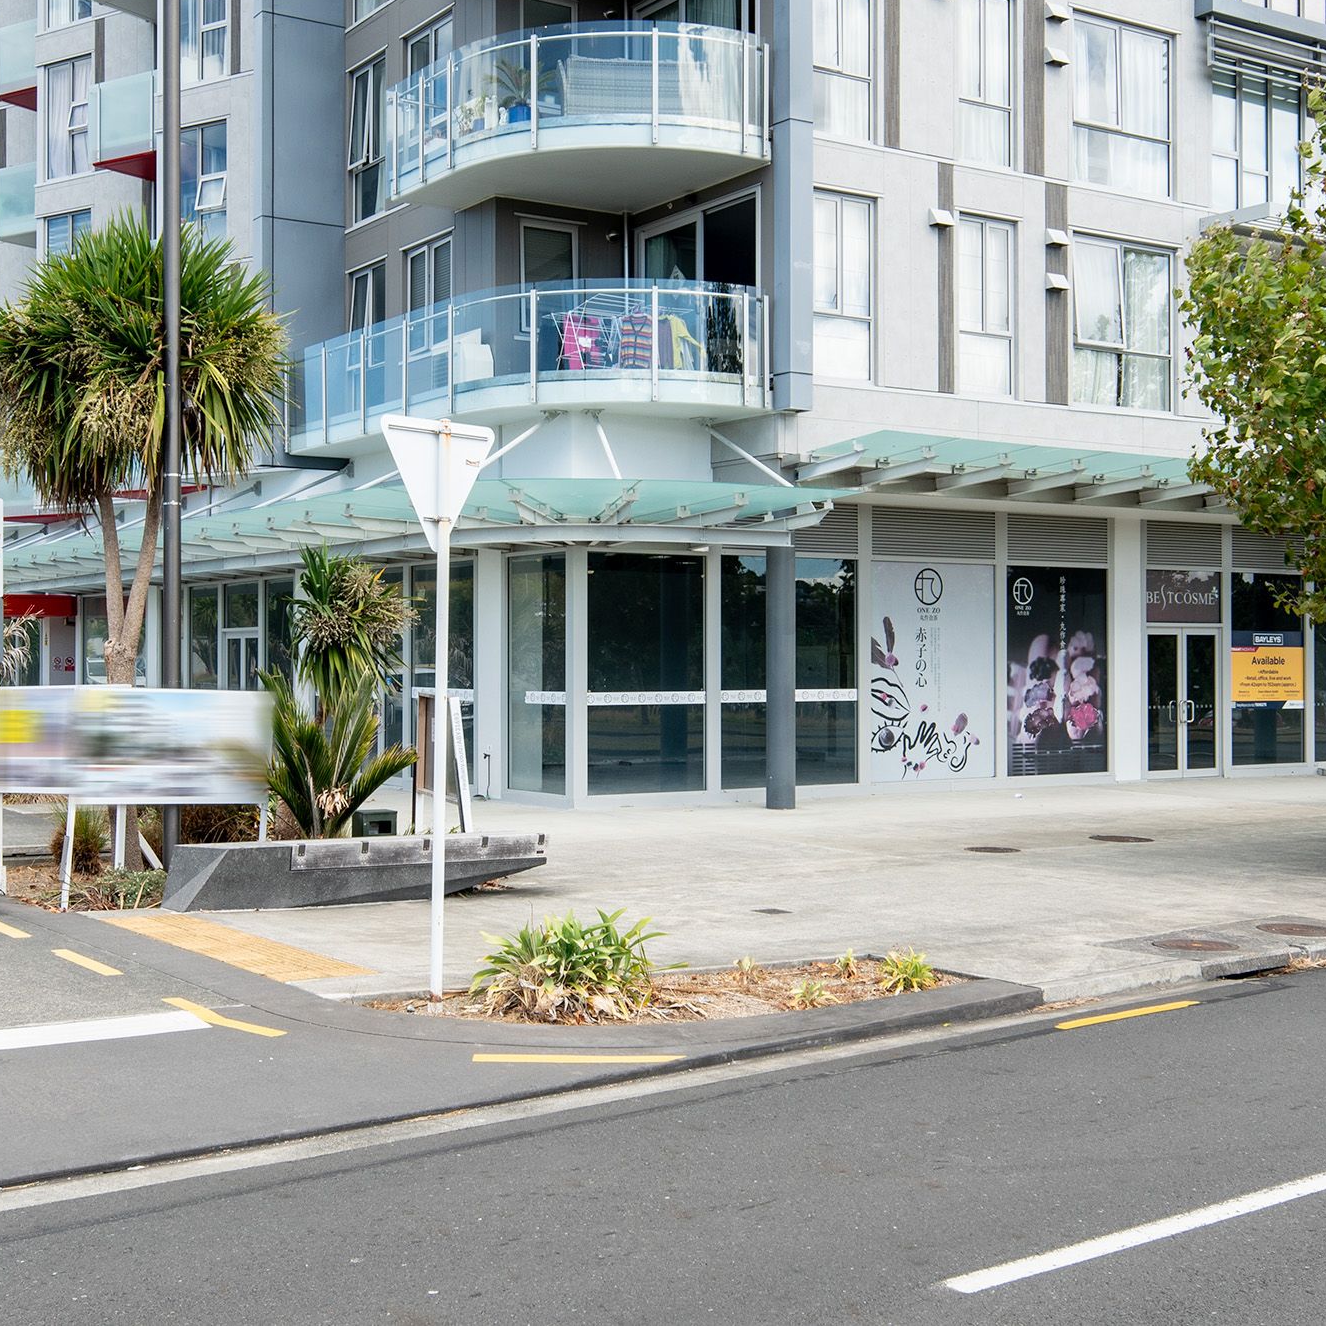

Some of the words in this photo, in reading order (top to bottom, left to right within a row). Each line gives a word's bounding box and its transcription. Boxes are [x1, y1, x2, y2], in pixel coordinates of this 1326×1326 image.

[915, 626, 927, 688] 赤子の心
[1251, 656, 1285, 665] Available
